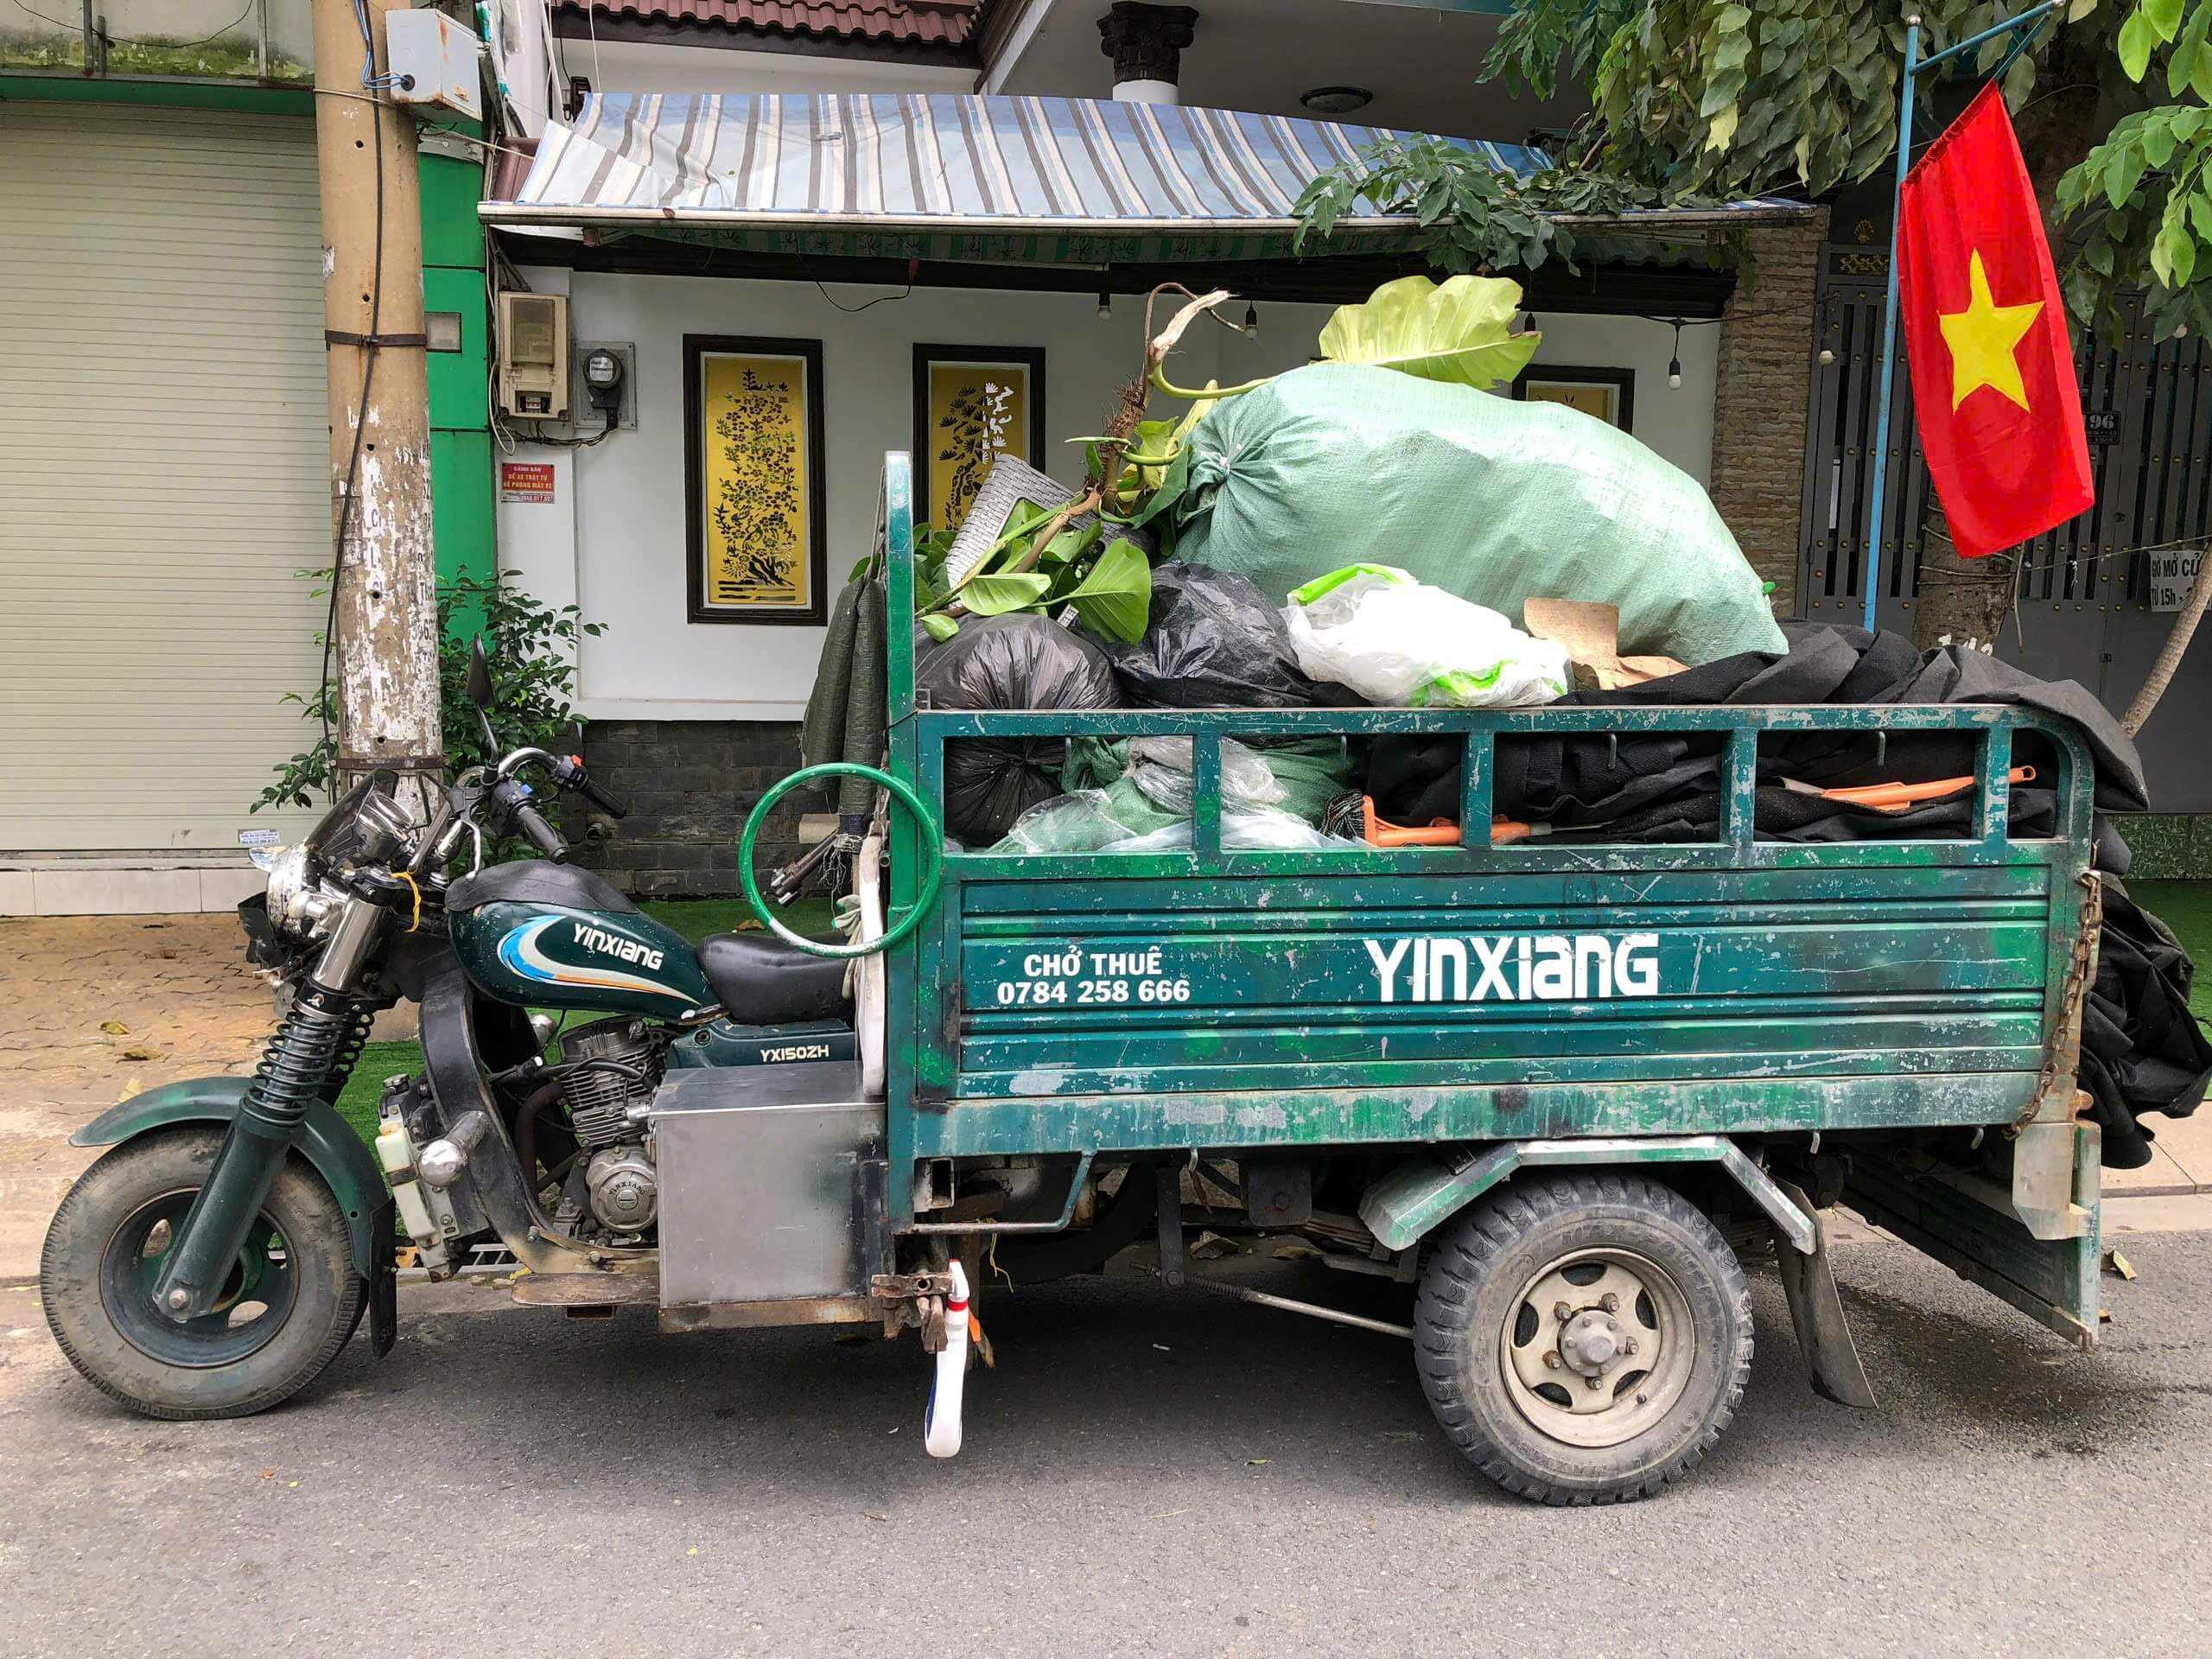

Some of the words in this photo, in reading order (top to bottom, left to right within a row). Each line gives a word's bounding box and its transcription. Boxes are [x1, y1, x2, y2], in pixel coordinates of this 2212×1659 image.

[2089, 415, 2114, 429] 96
[2163, 553, 2178, 577] MỞ
[2161, 588, 2176, 606] 15h
[1024, 944, 1083, 976] CHỞ
[1090, 945, 1162, 976] THUÊ
[997, 982, 1067, 1005] 0784
[1077, 981, 1129, 1003] 258
[1138, 980, 1190, 1002] 666
